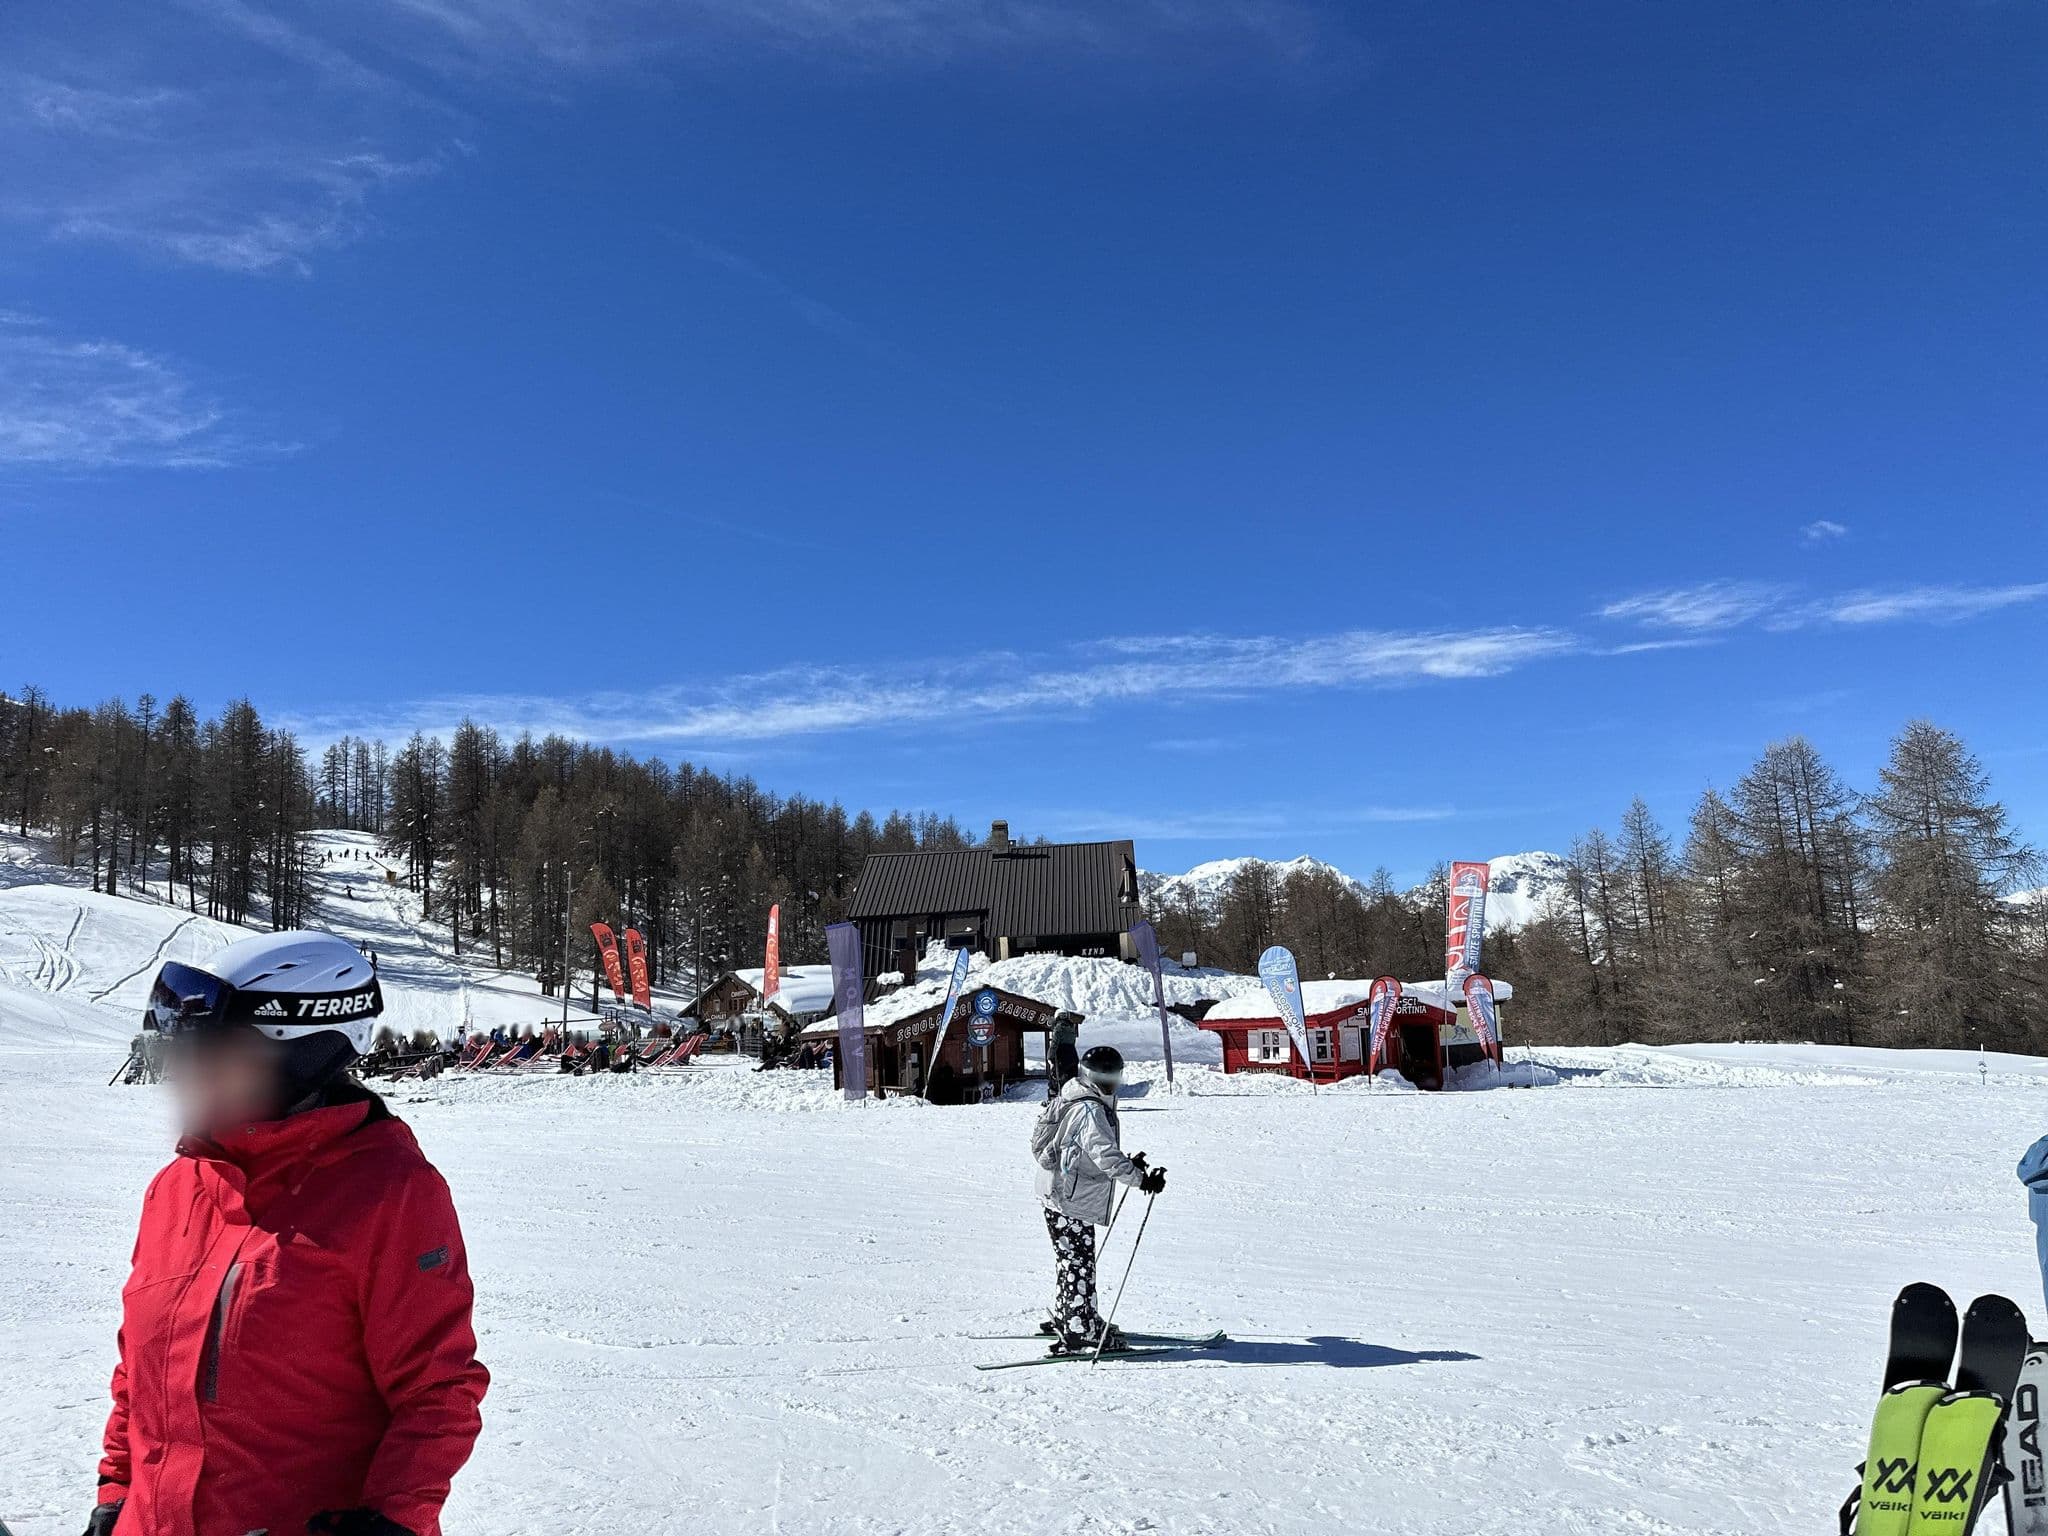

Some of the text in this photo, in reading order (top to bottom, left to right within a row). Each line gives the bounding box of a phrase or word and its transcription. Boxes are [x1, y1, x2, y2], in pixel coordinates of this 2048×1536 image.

[1470, 898, 1484, 966] SAUZE SPORTINIA
[1081, 947, 1105, 956] KIND
[254, 992, 374, 1017] adidas TERREX
[1382, 996, 1398, 1029] SPORTINIA
[1396, 1005, 1427, 1015] ORTINIA
[897, 1013, 943, 1041] SCUOLA
[953, 1002, 972, 1019] SCI
[997, 1001, 1036, 1022] SAUZE
[1920, 1510, 1965, 1521] Völkl
